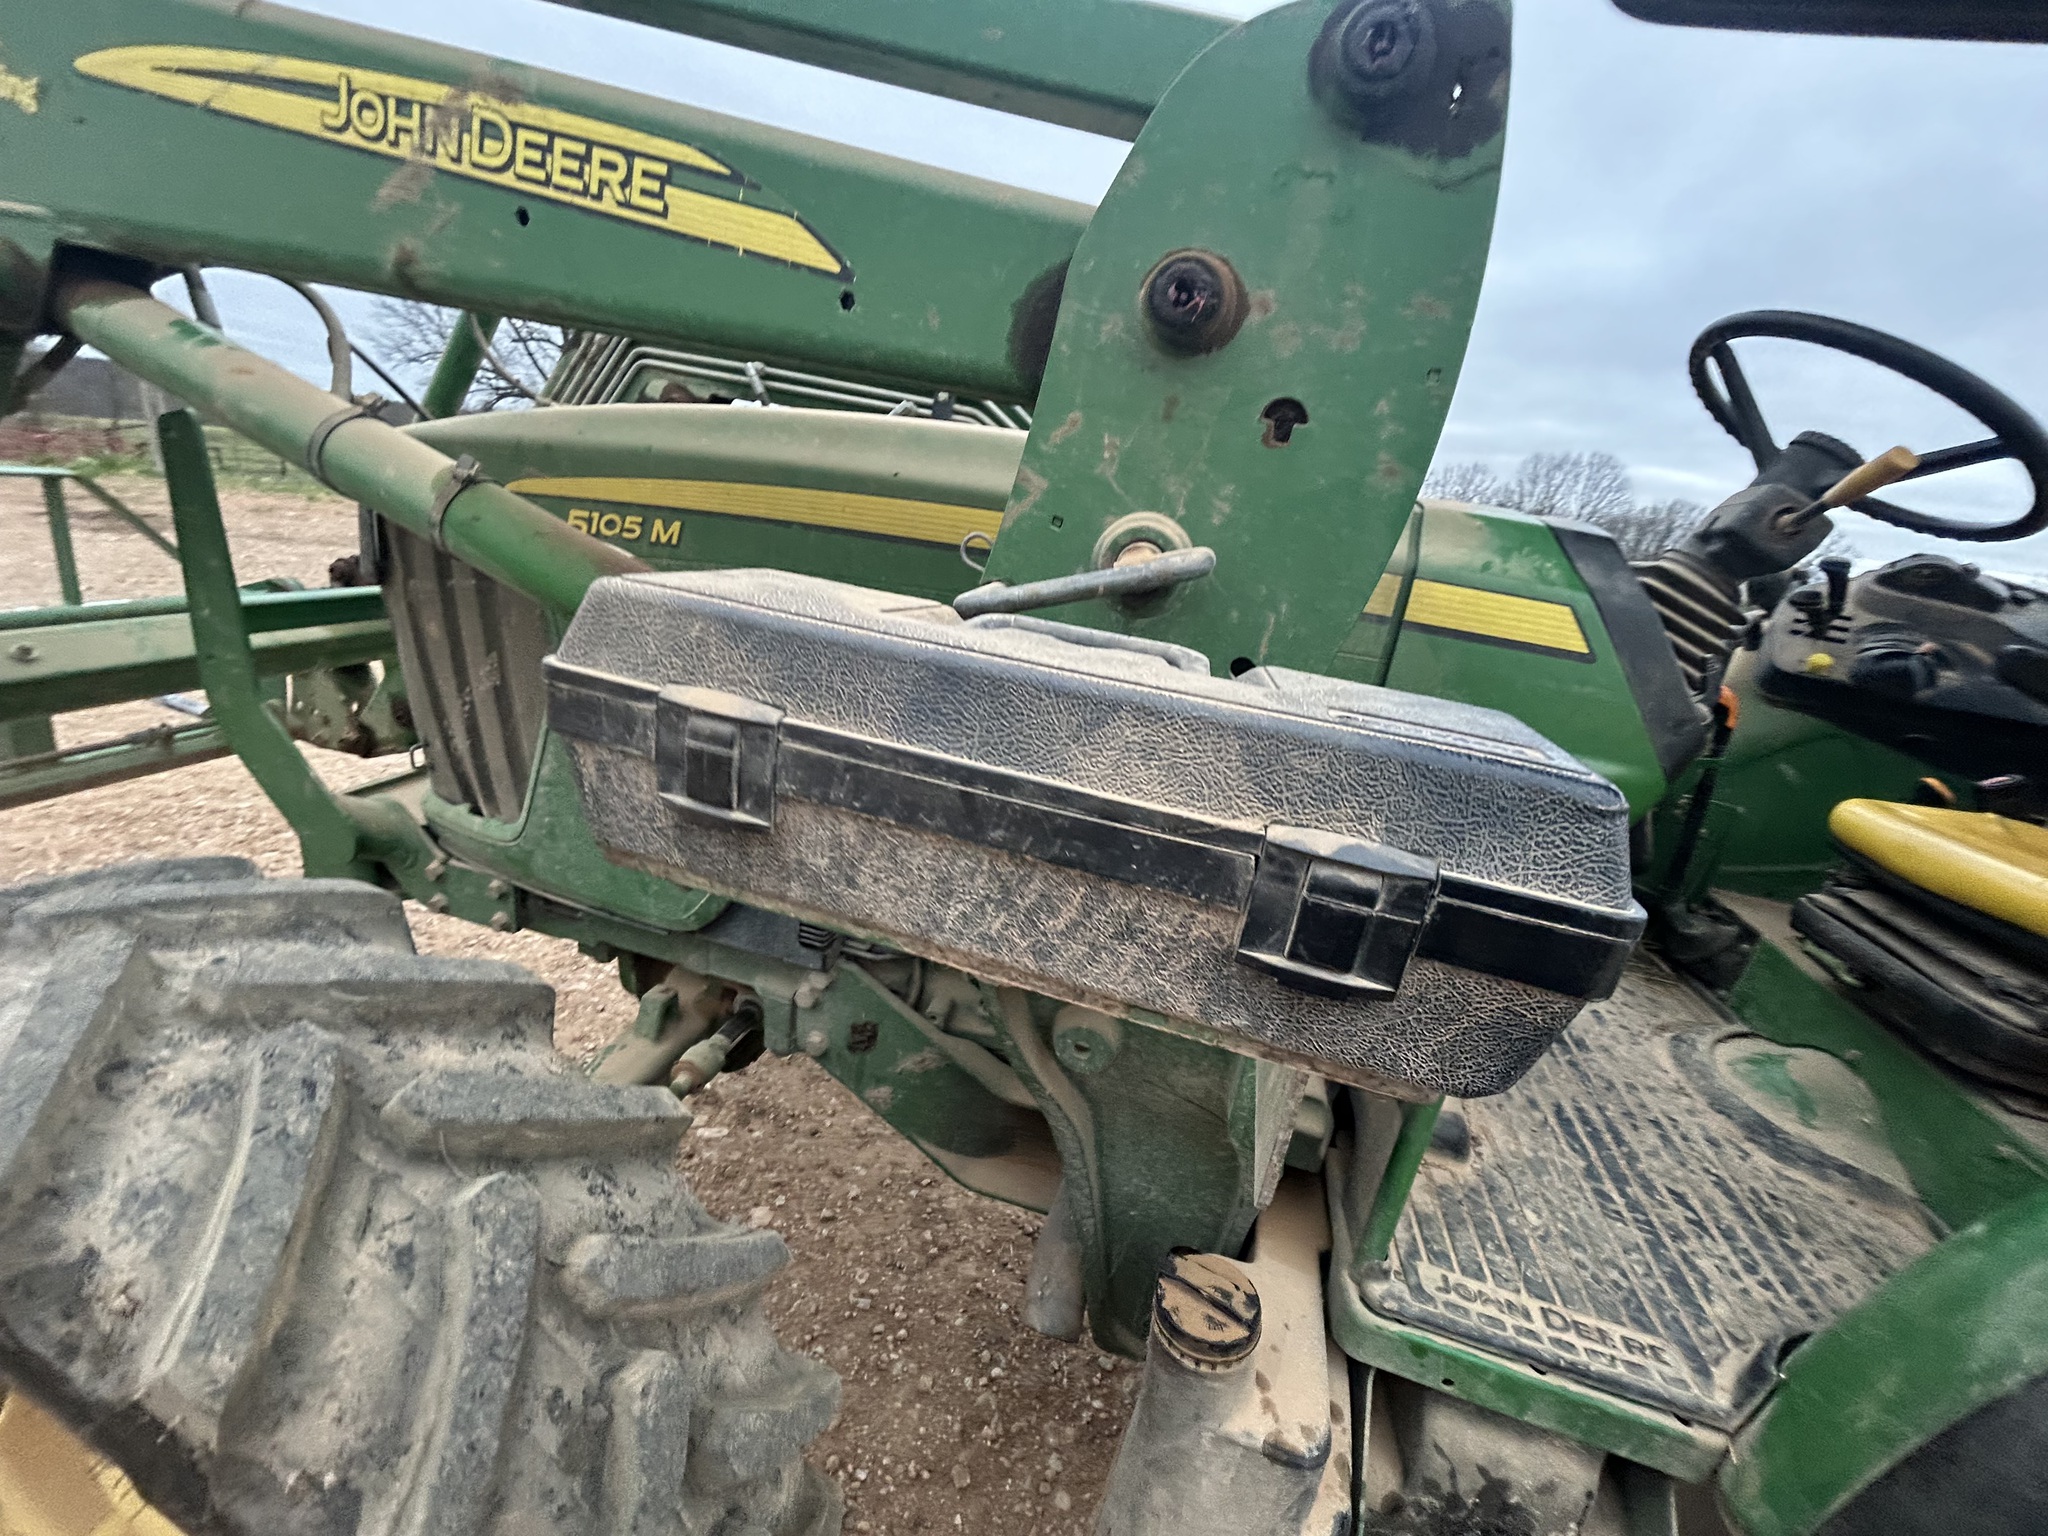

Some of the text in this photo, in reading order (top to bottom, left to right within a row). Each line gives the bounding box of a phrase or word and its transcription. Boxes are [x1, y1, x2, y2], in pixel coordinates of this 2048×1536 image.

[320, 72, 669, 217] JOHN DEERE
[650, 518, 682, 546] M
